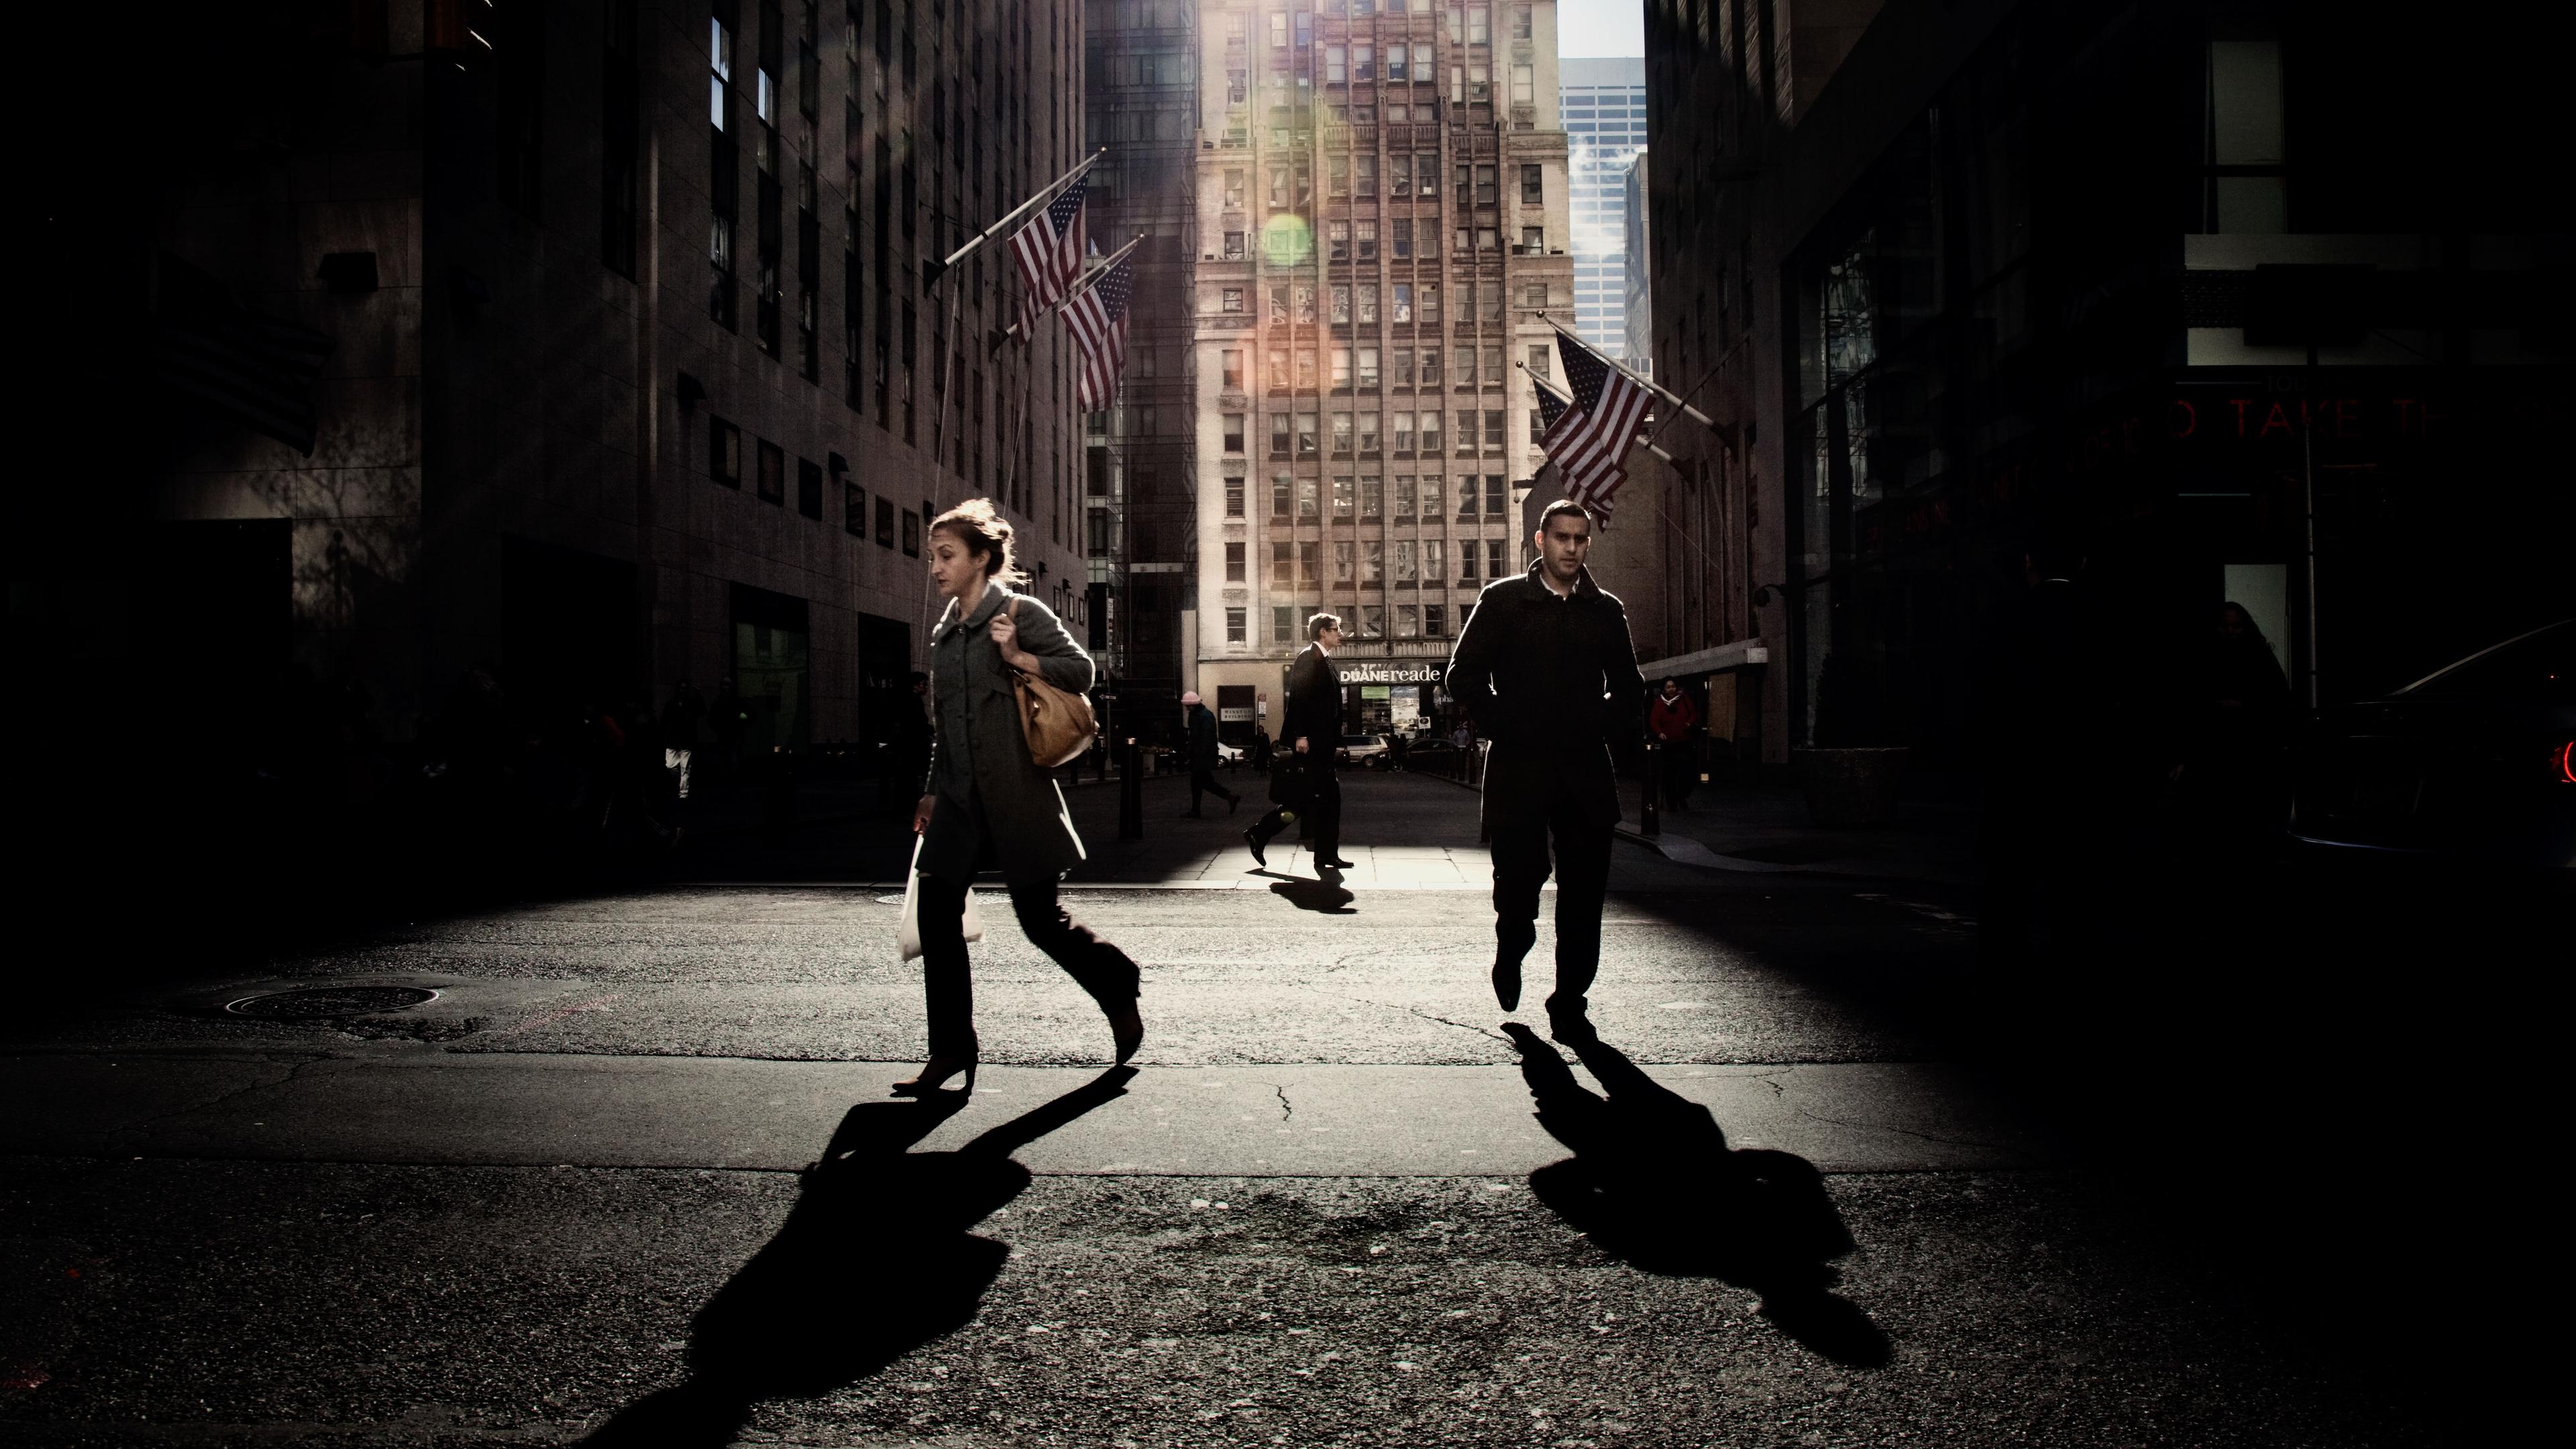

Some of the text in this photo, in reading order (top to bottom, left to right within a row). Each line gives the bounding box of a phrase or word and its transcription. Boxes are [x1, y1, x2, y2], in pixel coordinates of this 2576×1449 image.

[2227, 398, 2361, 439] TAKE
[1340, 665, 1440, 682] DUANE reade
